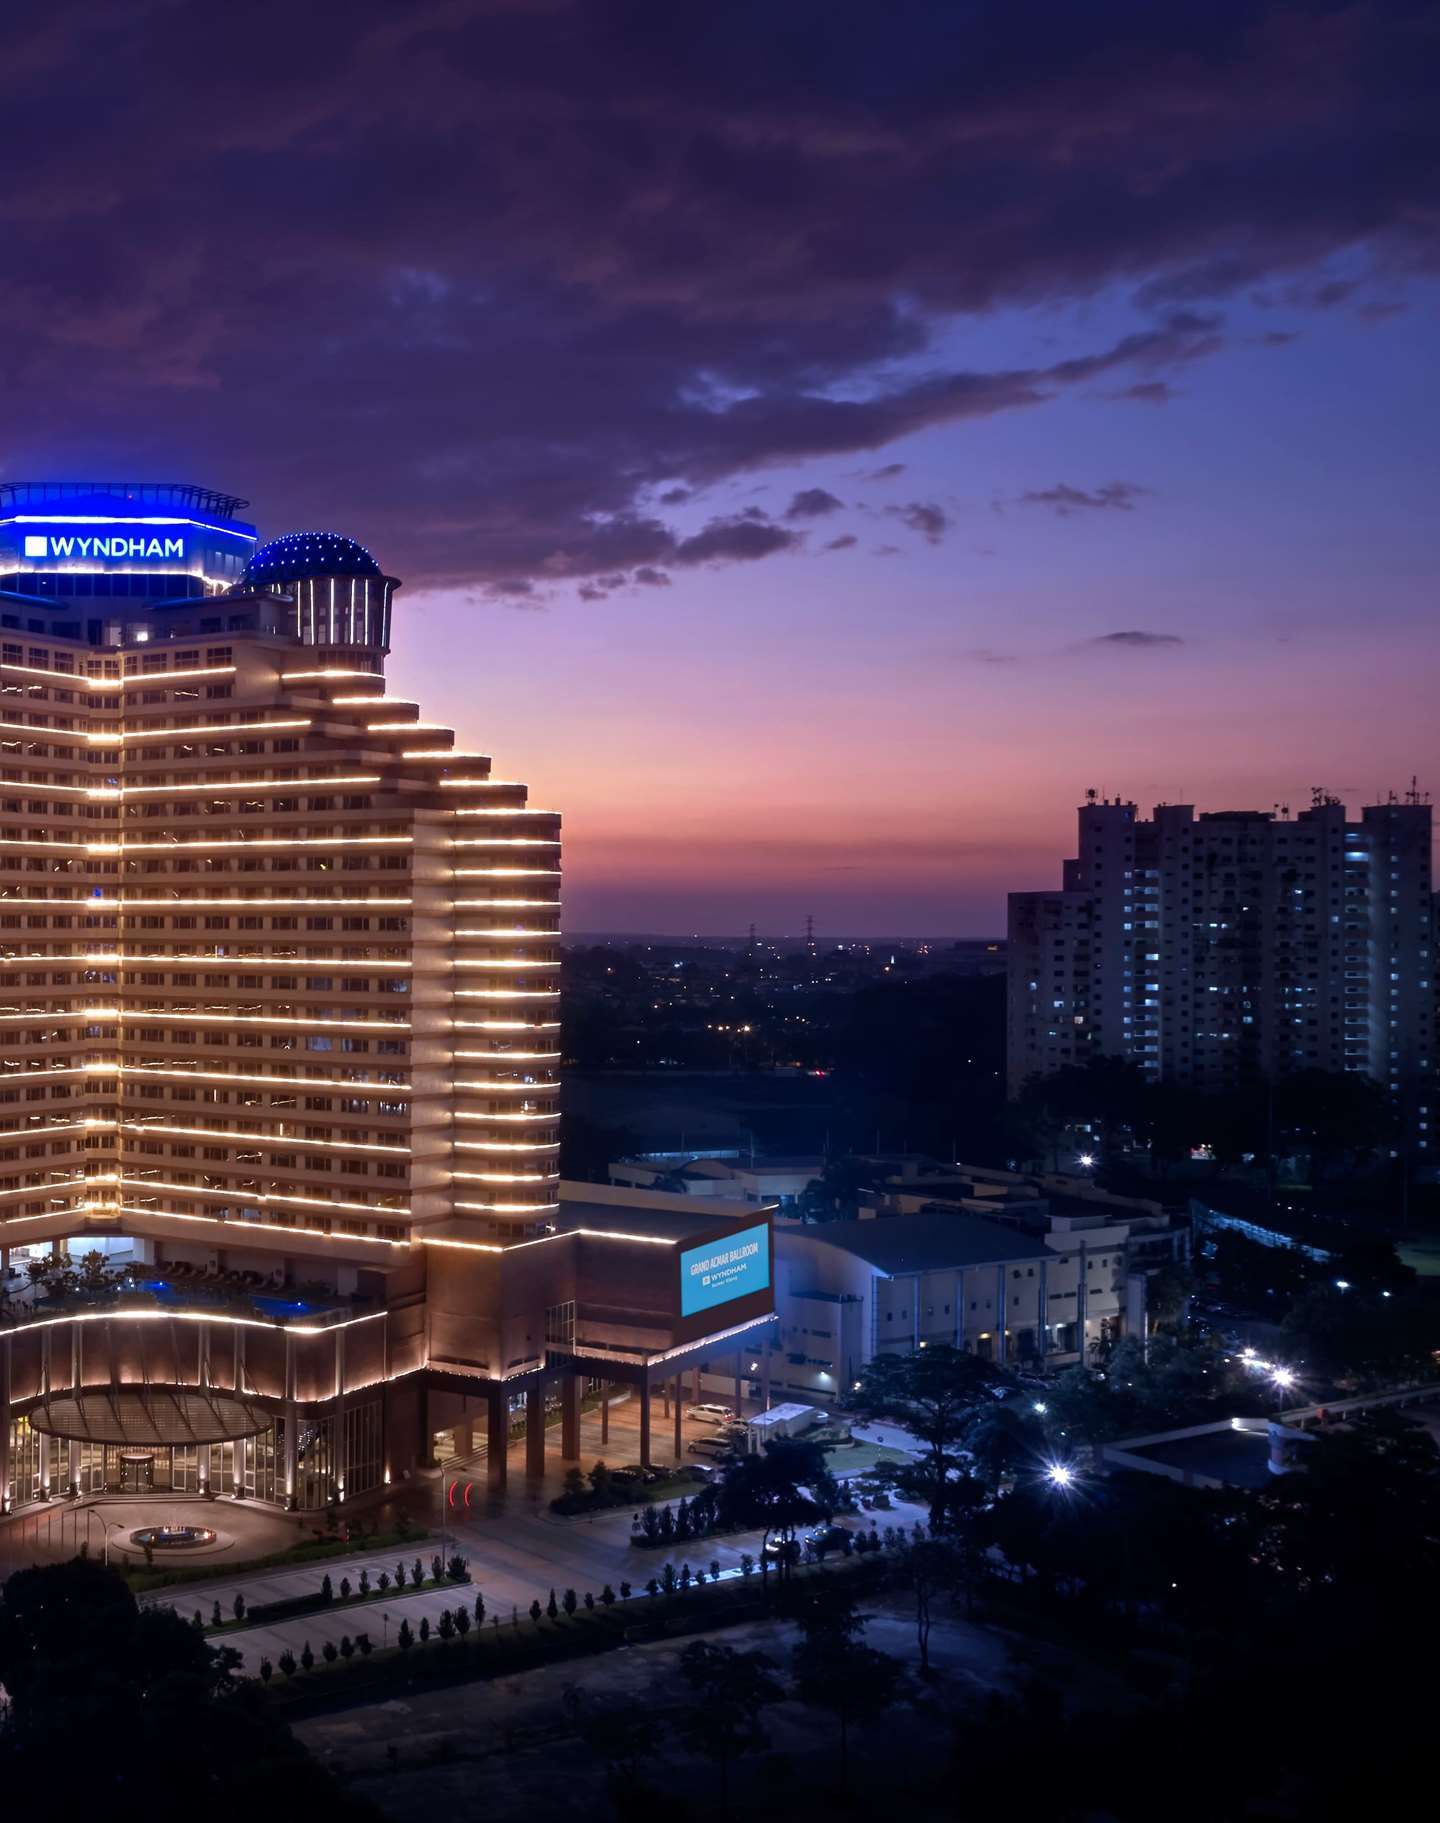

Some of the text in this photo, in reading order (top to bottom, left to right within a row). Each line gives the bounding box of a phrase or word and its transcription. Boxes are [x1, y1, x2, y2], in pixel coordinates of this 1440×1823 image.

[50, 536, 184, 558] WYNDHAM
[690, 1242, 759, 1276] GRAND ACMAR BALLROOM
[711, 1263, 747, 1281] WYNDHAM
